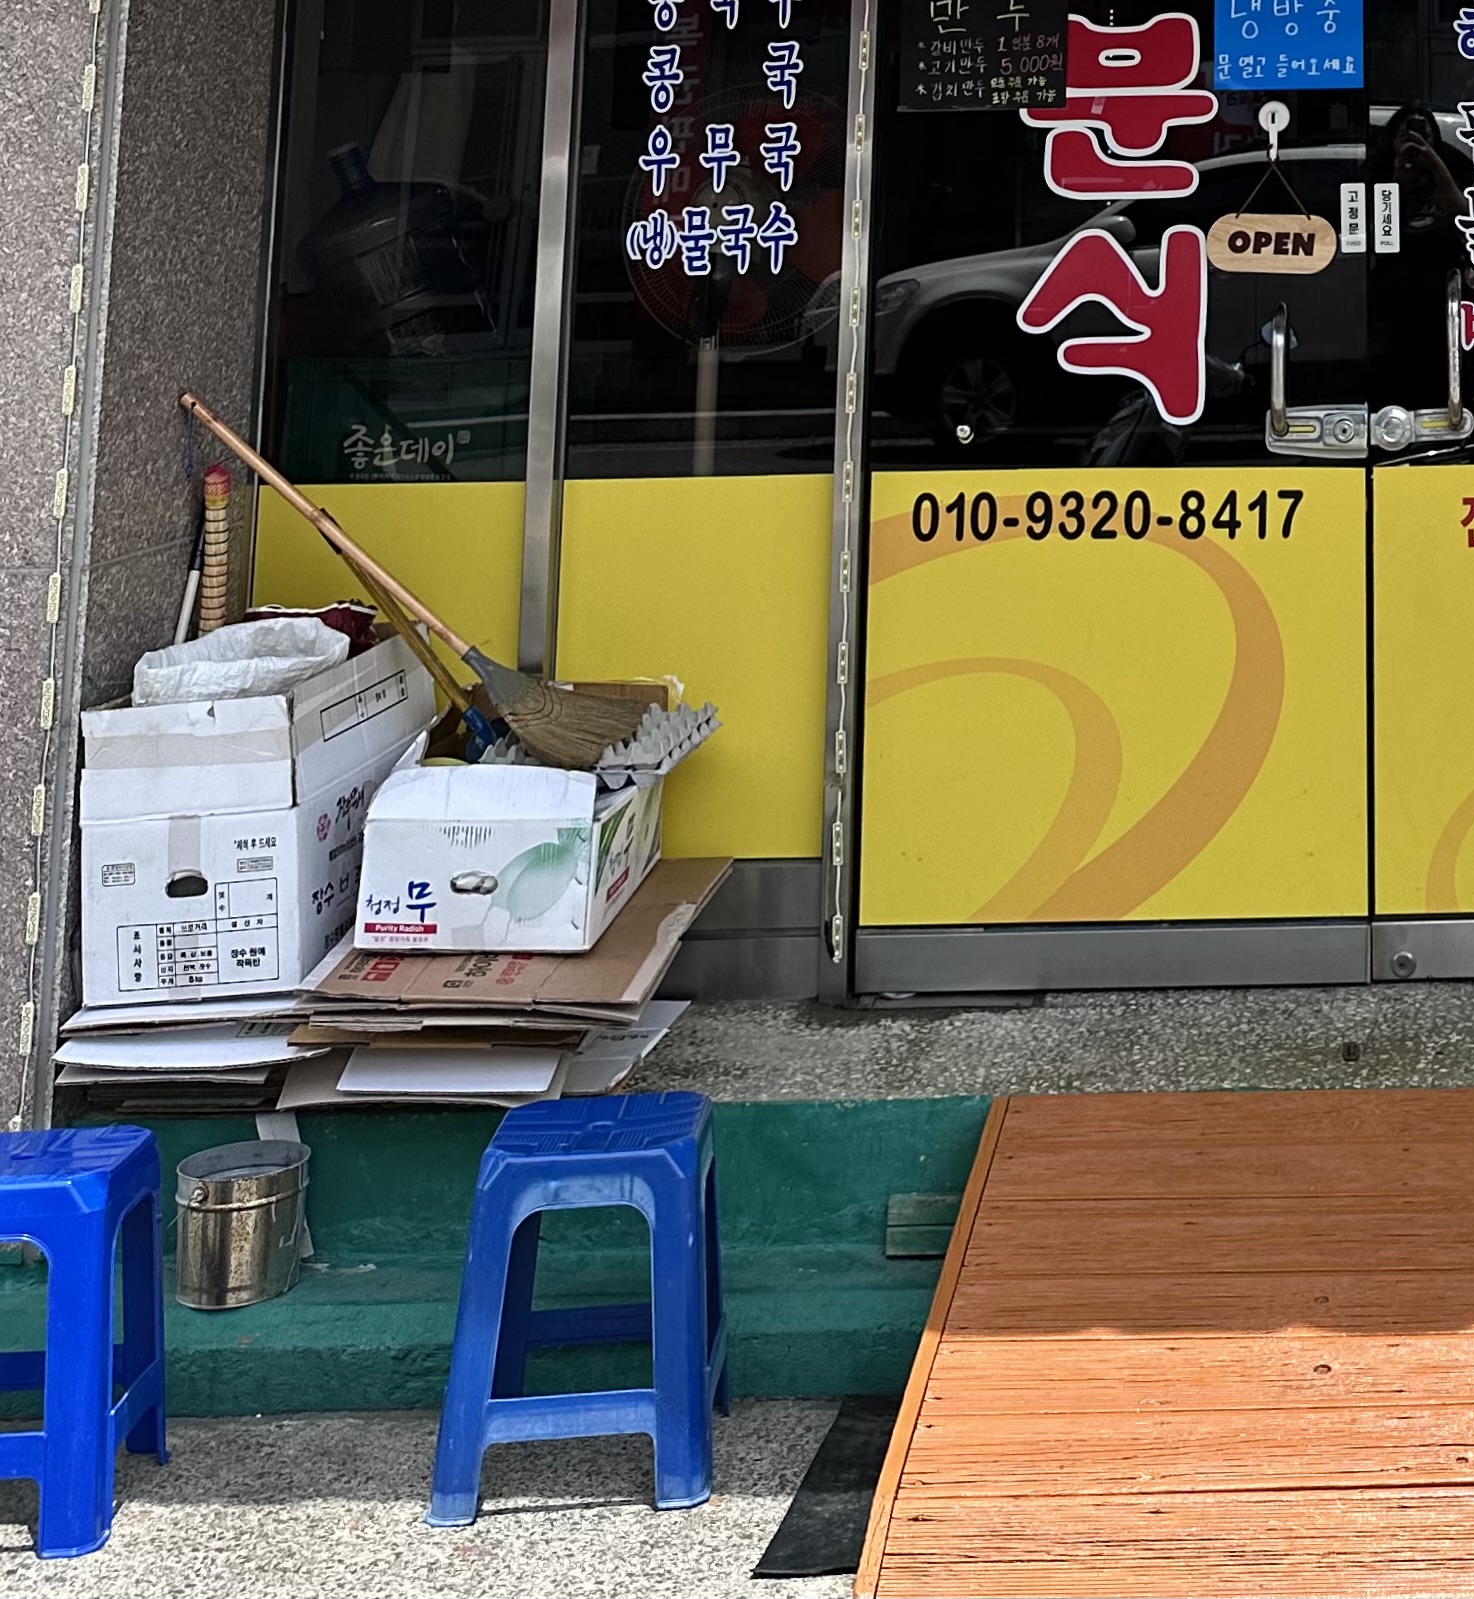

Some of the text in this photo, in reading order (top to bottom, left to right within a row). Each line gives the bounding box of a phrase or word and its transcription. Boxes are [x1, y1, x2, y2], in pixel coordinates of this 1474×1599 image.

[1217, 54, 1356, 80] 문 열고 들어오세요
[1382, 190, 1392, 236] 당기세요
[1227, 230, 1316, 257] OPEN
[343, 424, 454, 469] 좋은데이
[912, 489, 1304, 543] 010-9320-8417
[366, 881, 437, 923] 청정 무
